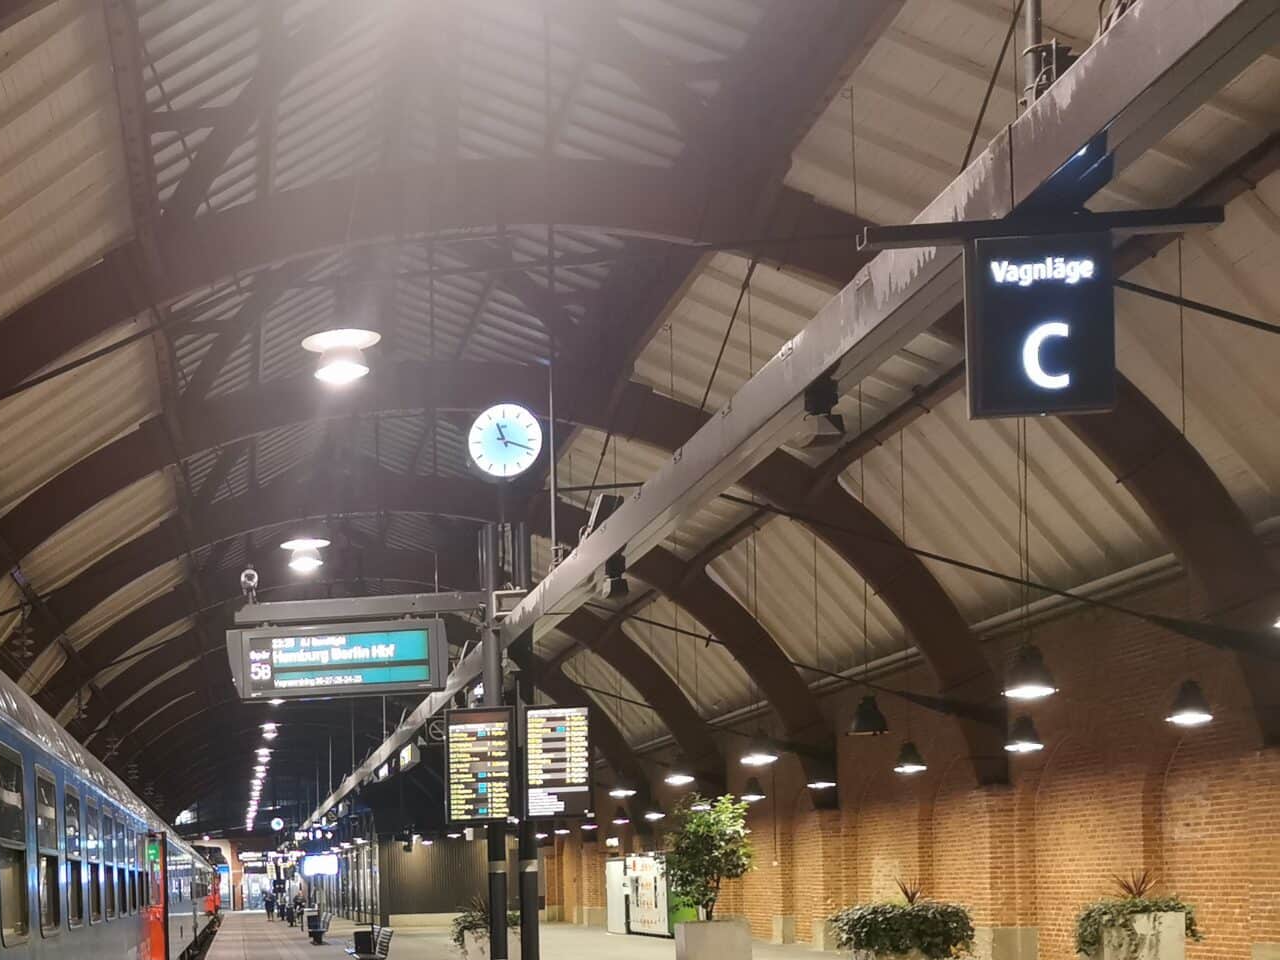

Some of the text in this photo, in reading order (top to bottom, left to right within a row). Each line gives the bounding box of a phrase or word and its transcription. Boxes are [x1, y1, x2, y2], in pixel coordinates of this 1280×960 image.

[990, 257, 1095, 286] Vagnläge
[1022, 321, 1070, 389] C
[272, 648, 329, 664] Hamburg
[331, 645, 370, 661] Berlin
[250, 662, 272, 681] 58
